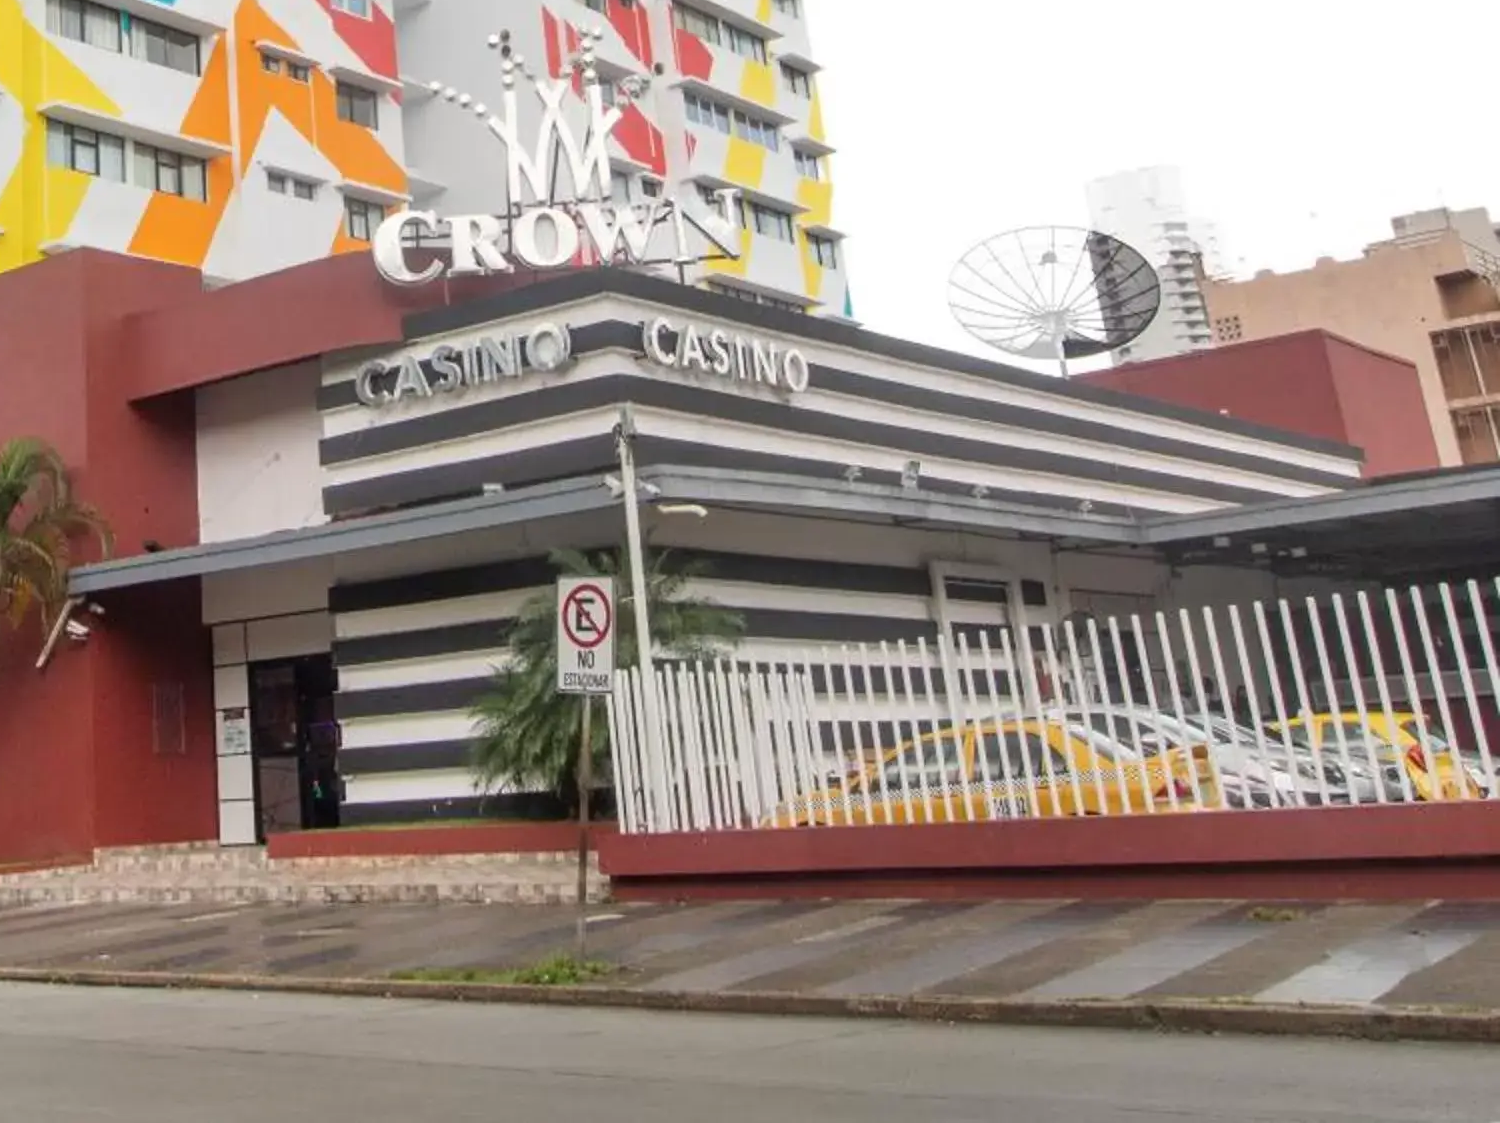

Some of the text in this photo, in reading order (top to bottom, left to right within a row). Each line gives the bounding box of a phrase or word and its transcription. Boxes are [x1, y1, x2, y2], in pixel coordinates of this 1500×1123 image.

[372, 187, 742, 284] CROWN
[355, 321, 572, 406] CASINO
[641, 315, 810, 394] CASINO
[576, 598, 595, 632] E
[563, 672, 609, 687] ESTACIONAR
[577, 650, 595, 669] NO
